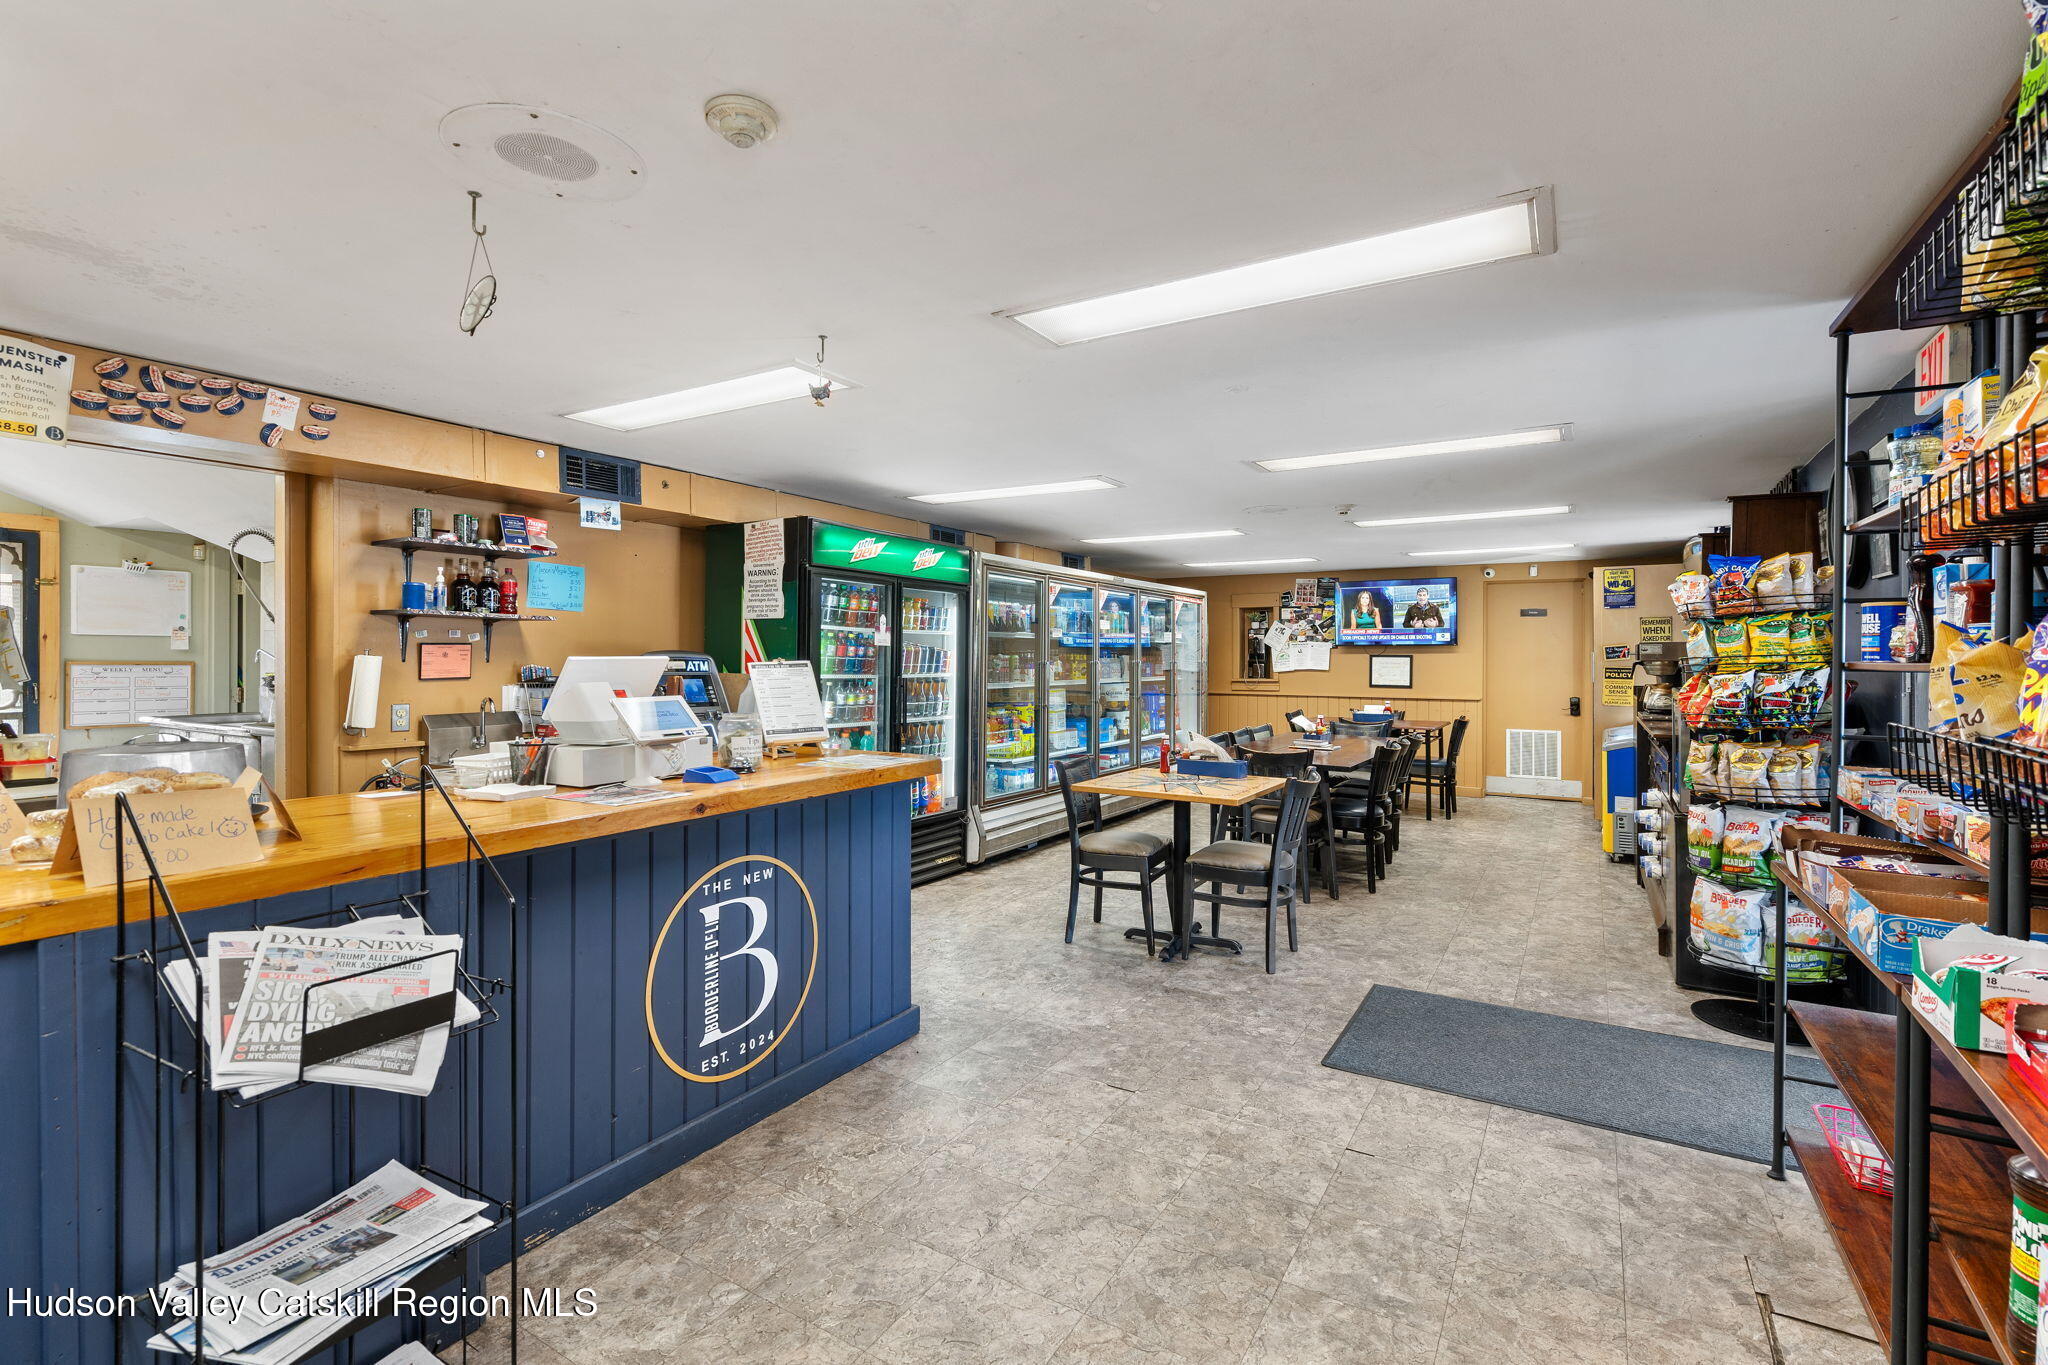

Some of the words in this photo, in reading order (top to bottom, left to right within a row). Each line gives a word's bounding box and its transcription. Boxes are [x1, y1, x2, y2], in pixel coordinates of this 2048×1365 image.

[1920, 331, 1945, 407] EXIT
[31, 411, 50, 421] Roll
[748, 567, 779, 577] WARNING:
[1607, 580, 1632, 588] WD-40
[1642, 626, 1666, 635] WHEN
[686, 660, 709, 672] ATM
[702, 878, 732, 896] THE
[743, 867, 775, 886] NEW
[1786, 916, 1822, 928] OULDER
[1906, 920, 1950, 938] Drake'
[270, 933, 349, 949] DAILY
[356, 939, 434, 951] NEWS
[335, 952, 366, 961] TRUMP
[391, 954, 425, 963] CHAR
[1788, 954, 1807, 962] LIVE
[336, 960, 357, 968] KIRK
[360, 961, 423, 971] ASSASNATED
[699, 896, 779, 1048] B
[1986, 977, 1998, 985] 18
[704, 949, 719, 1033] BORDERLINE
[247, 1001, 343, 1024] DYING,
[247, 1052, 265, 1060] NYC
[701, 1050, 730, 1073] EST.
[739, 1029, 775, 1055] 2024
[383, 1058, 400, 1070] toxic
[401, 1063, 411, 1072] air
[210, 1222, 334, 1279] Democrat
